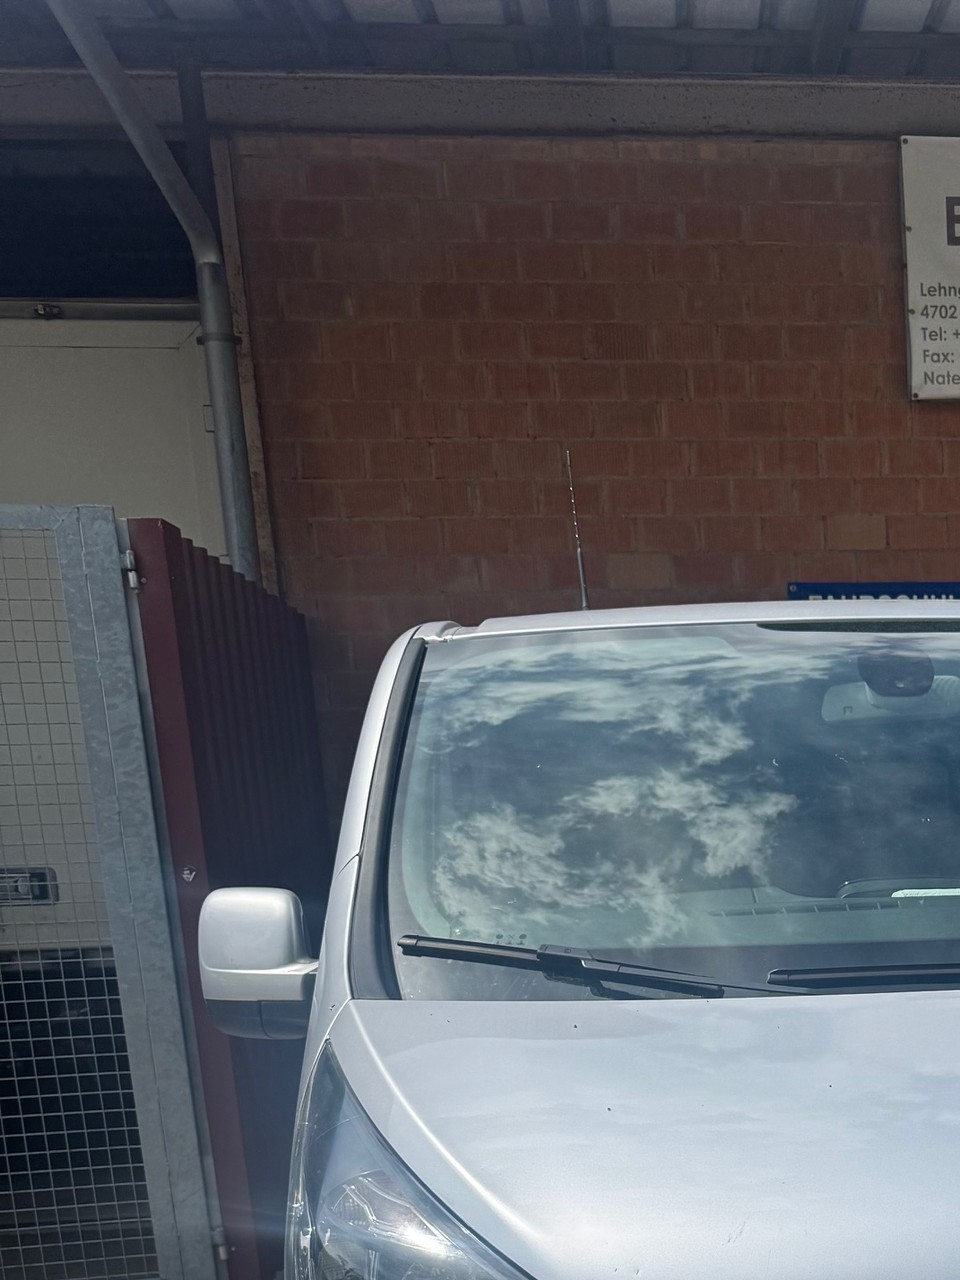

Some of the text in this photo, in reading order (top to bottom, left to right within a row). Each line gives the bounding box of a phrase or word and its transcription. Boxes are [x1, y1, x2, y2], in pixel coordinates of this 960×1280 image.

[920, 305, 957, 319] 4702
[921, 327, 947, 341] Tel:
[923, 350, 954, 363] Fax:
